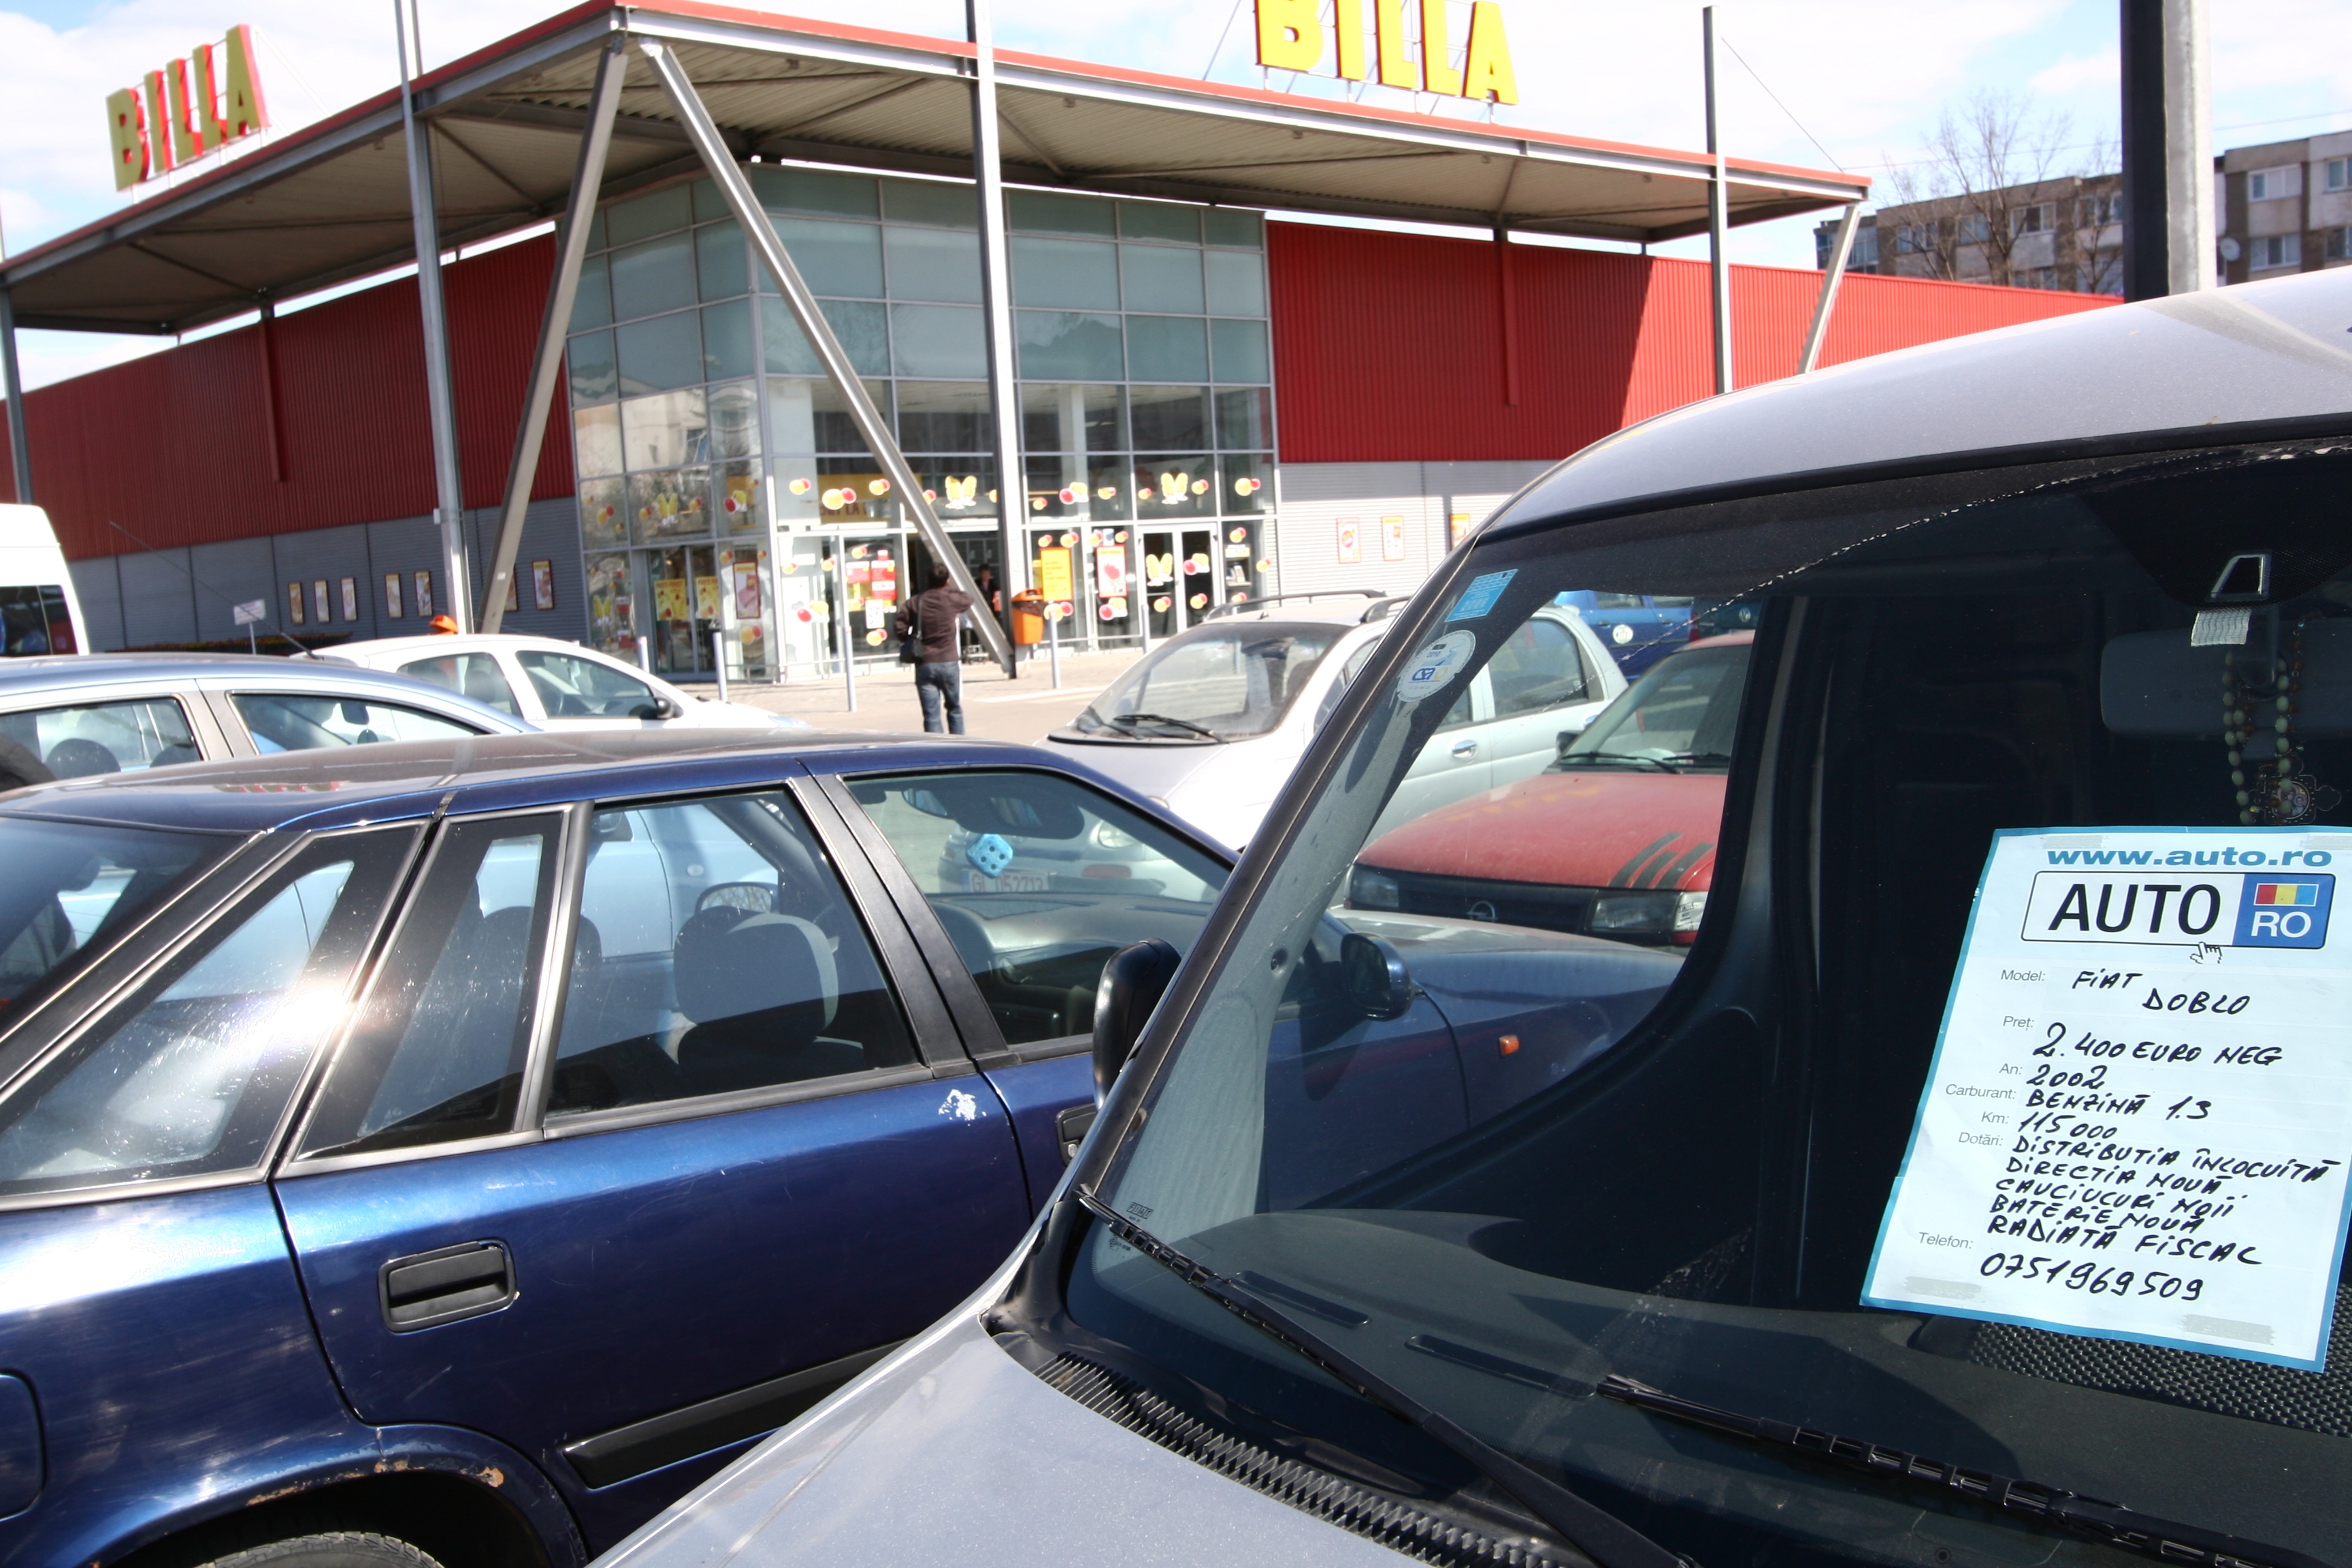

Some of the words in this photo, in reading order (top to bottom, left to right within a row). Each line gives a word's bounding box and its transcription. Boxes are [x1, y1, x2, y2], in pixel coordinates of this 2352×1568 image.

[1254, 0, 1520, 105] BILLA
[105, 23, 272, 193] BILLA
[2047, 847, 2332, 867] www.auto.ro
[2048, 883, 2221, 935] AUTO
[2251, 911, 2312, 938] RO
[2000, 969, 2046, 982] Model:
[2142, 987, 2251, 1015] DOBLO
[2033, 1022, 2127, 1059] 2.400
[2132, 1041, 2202, 1063] EURO
[2213, 1045, 2283, 1066] NEG
[1998, 1063, 2023, 1075] An:
[2026, 1064, 2108, 1090] 2002
[1945, 1083, 2016, 1100] Carburant:
[1981, 1111, 2010, 1124] Km:
[2165, 1096, 2212, 1121] 1.3
[1958, 1132, 2004, 1146] Dotări:
[1918, 1232, 1974, 1250] Telefon:
